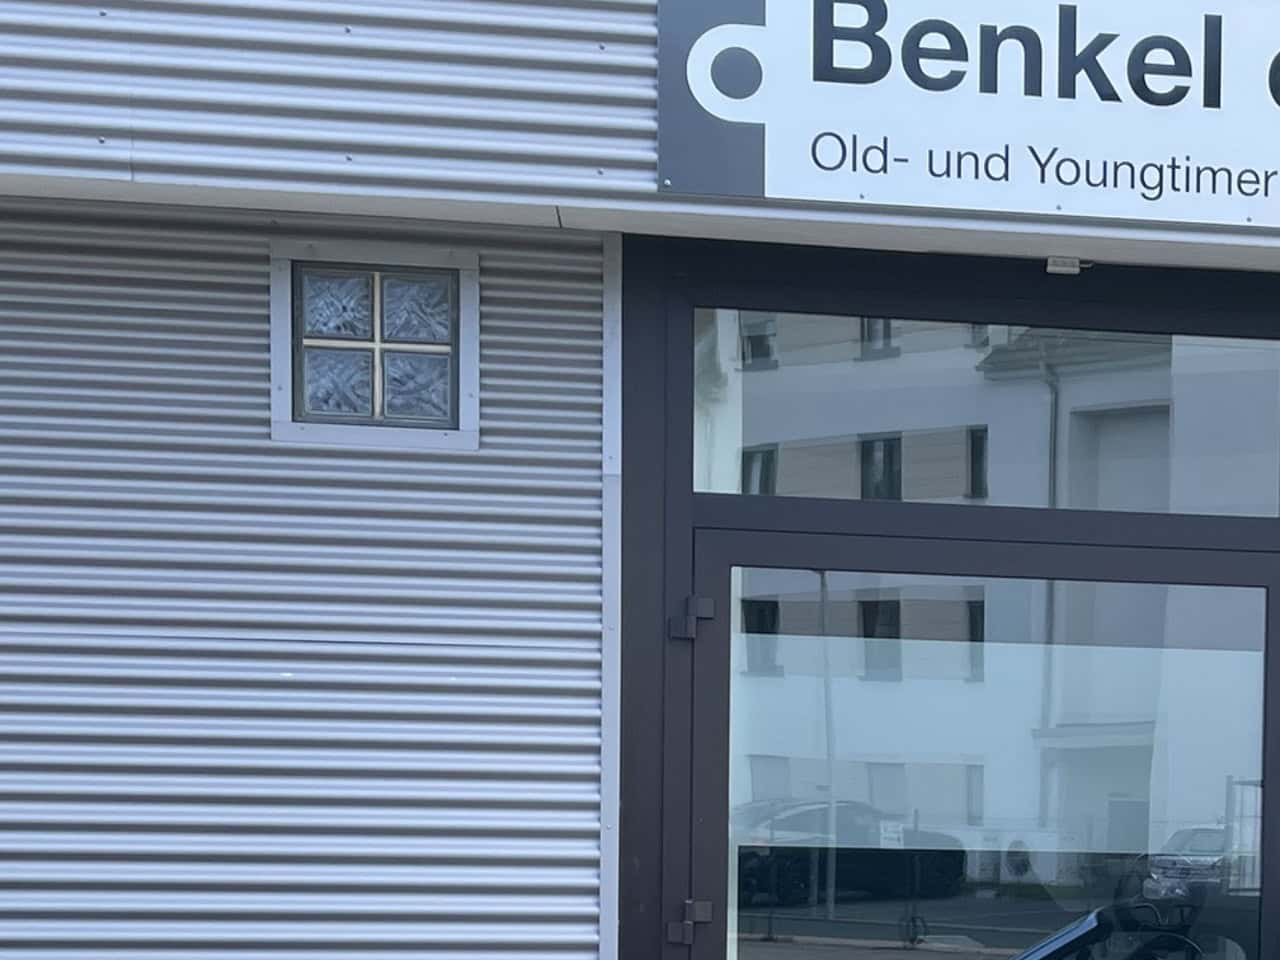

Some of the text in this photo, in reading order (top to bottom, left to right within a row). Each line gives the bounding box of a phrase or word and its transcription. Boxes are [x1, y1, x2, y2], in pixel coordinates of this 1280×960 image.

[811, 0, 1223, 110] Benkel
[809, 131, 910, 175] Old-
[926, 144, 1011, 183] und
[1028, 146, 1279, 201] Youngtimer
